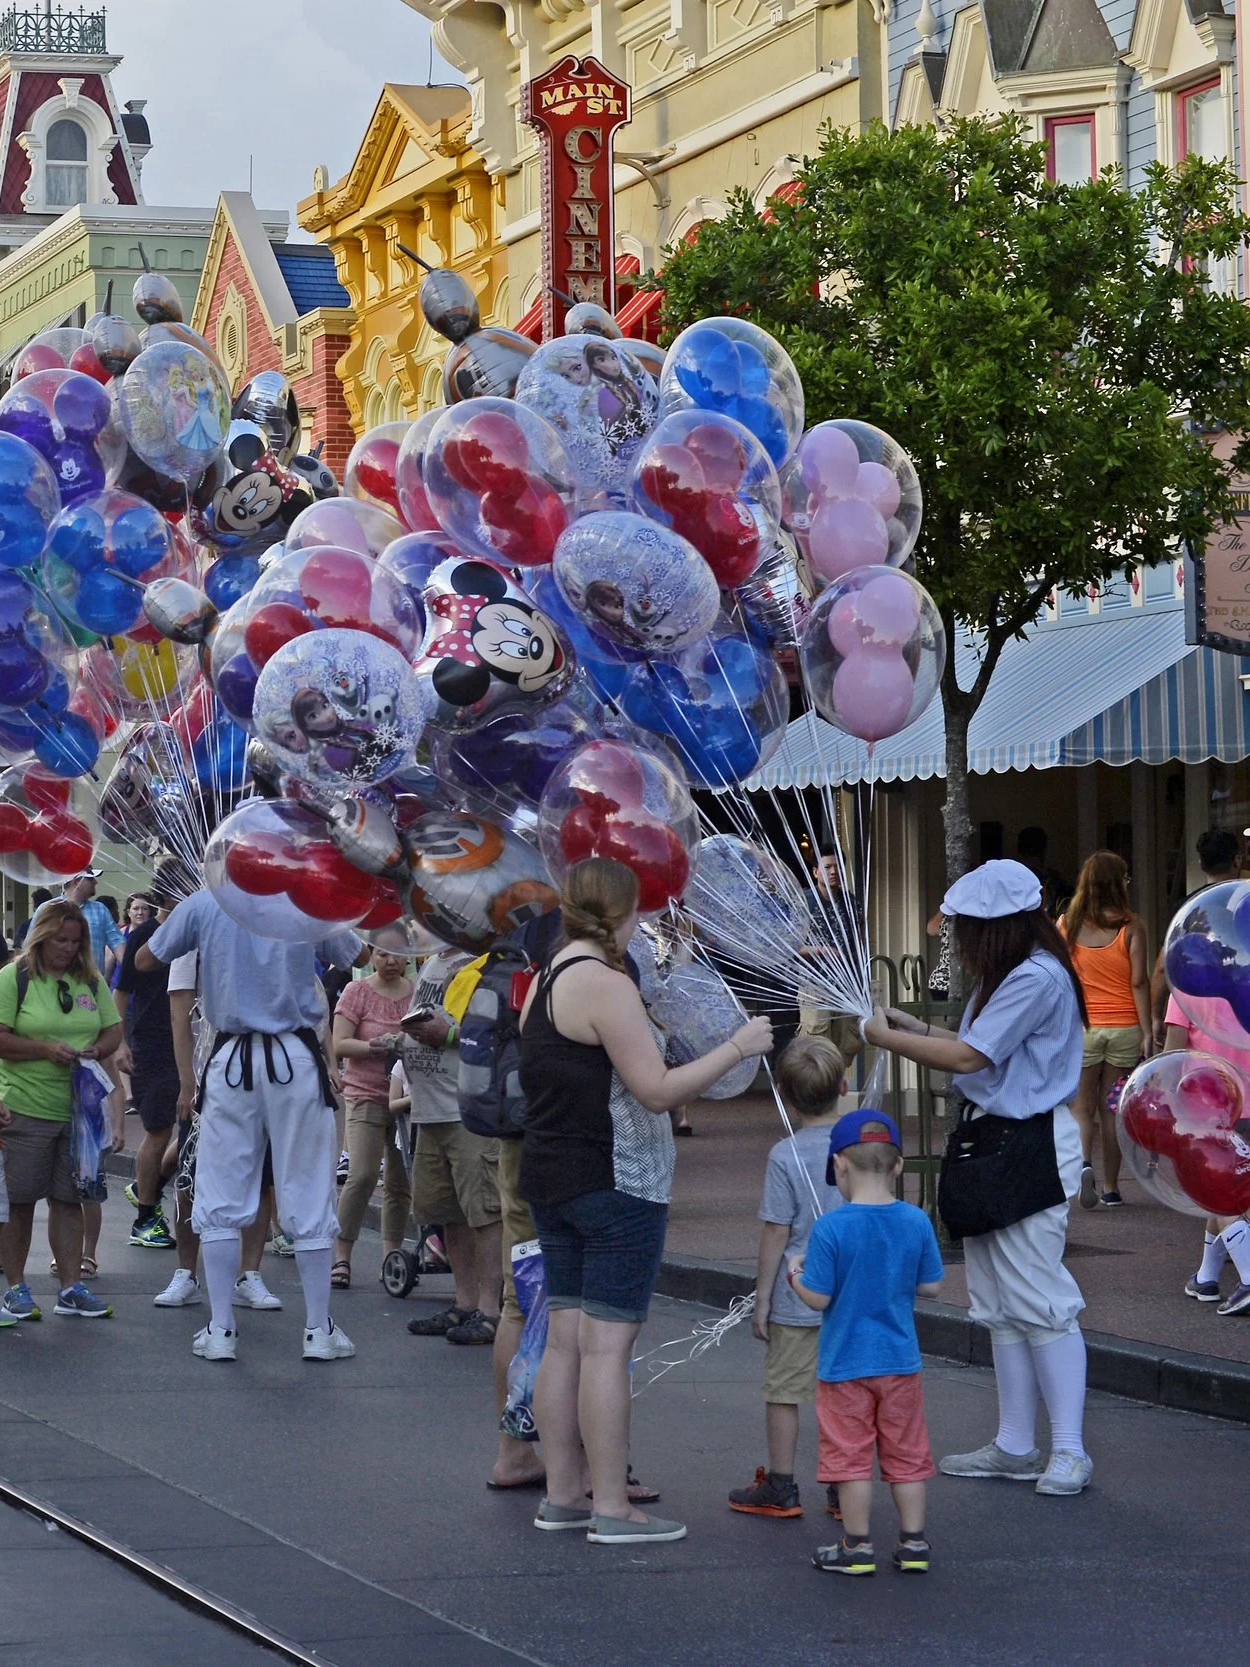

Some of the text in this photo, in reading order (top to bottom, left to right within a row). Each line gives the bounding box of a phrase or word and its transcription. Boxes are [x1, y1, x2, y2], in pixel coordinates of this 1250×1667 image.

[540, 83, 615, 109] MAIN
[586, 98, 624, 115] ST.
[563, 126, 608, 308] CINEM
[1218, 533, 1247, 551] The
